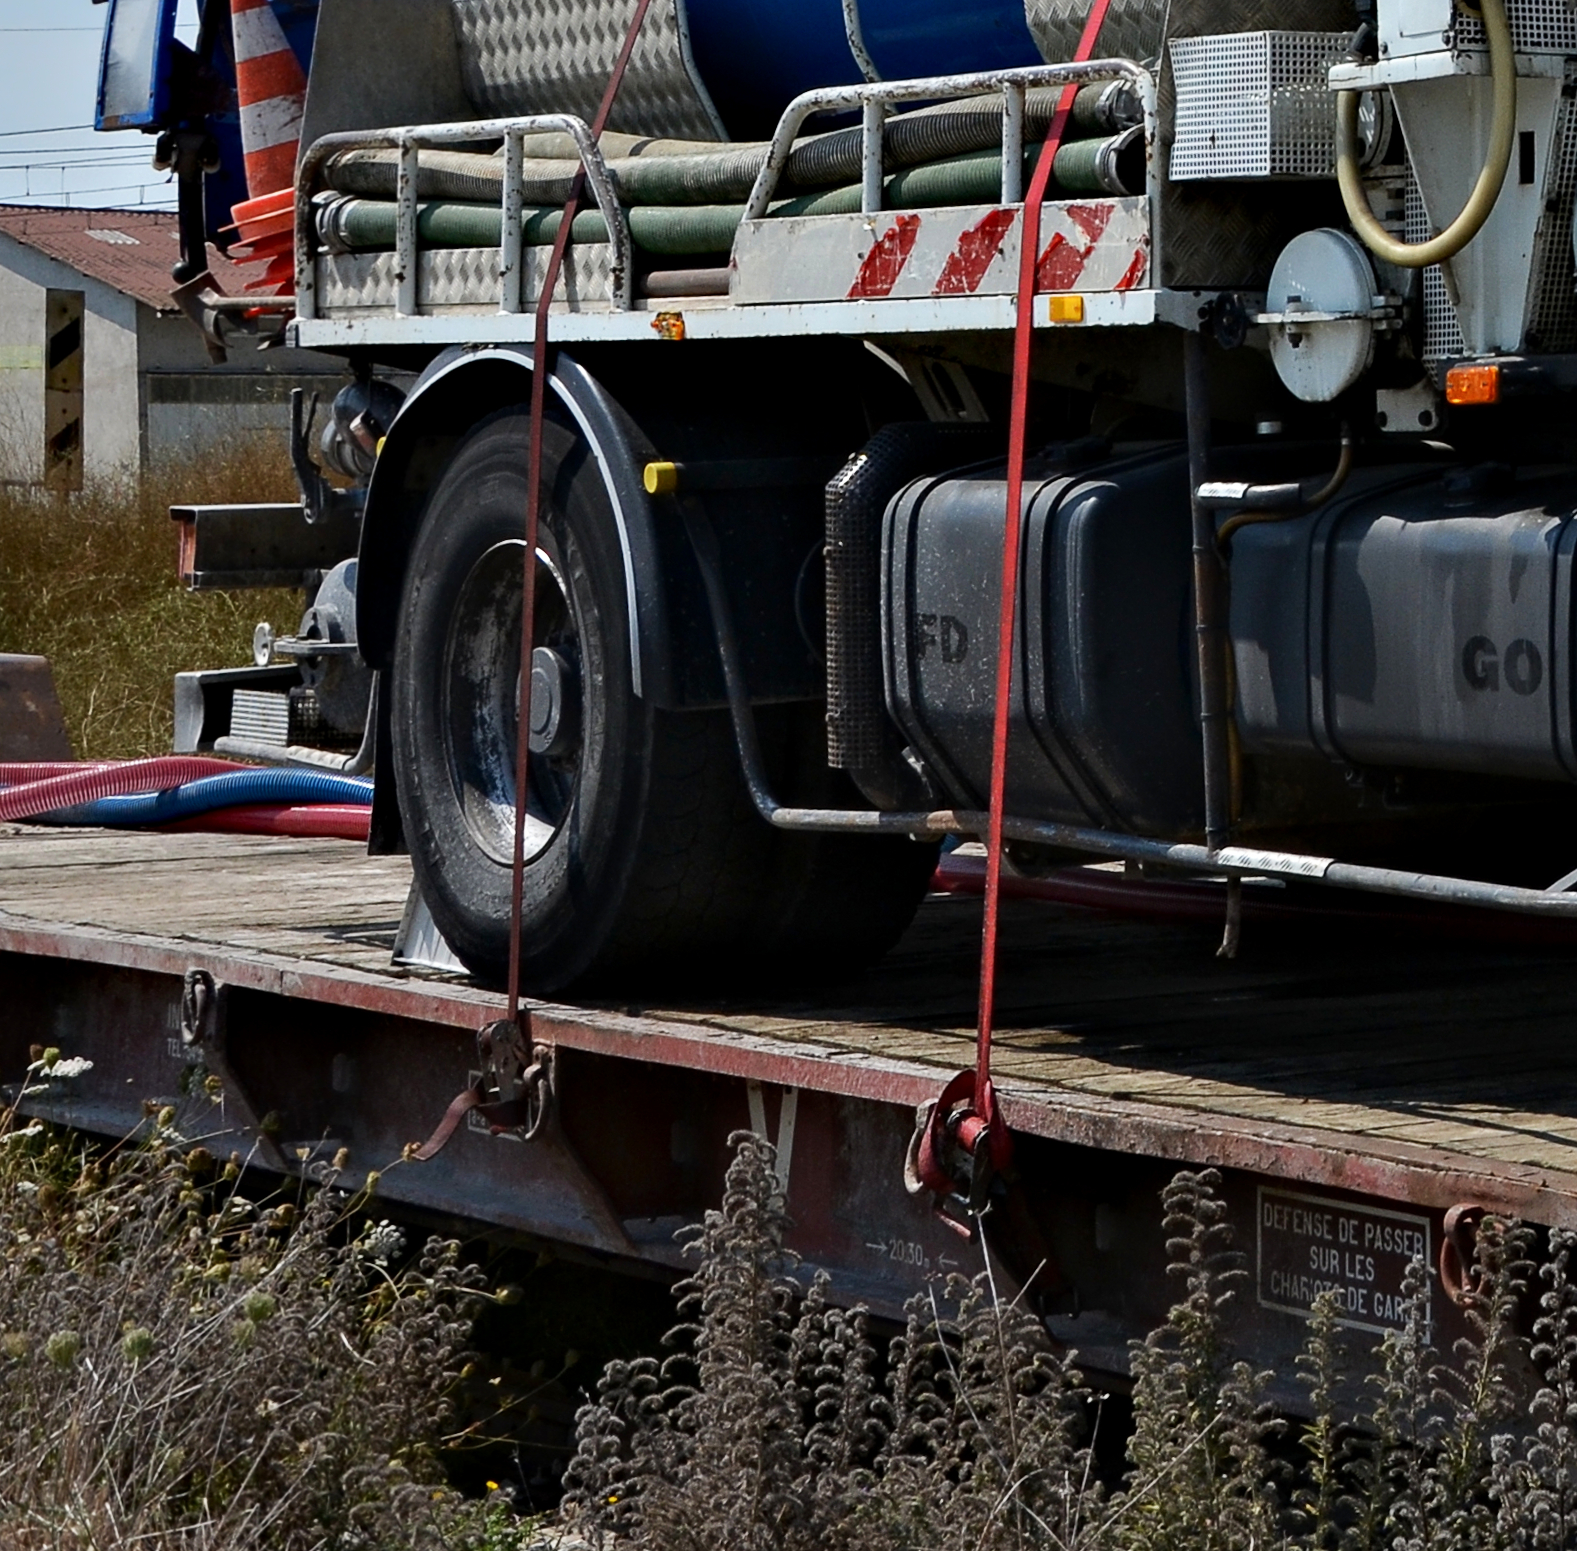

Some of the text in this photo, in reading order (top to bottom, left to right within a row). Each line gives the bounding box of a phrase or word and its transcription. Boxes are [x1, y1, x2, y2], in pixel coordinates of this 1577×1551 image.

[1462, 635, 1543, 695] GO
[1264, 1203, 1332, 1240] DEFENSE
[1339, 1218, 1358, 1245] DE
[1310, 1246, 1374, 1281] SUR LES
[1348, 1287, 1367, 1314] DE
